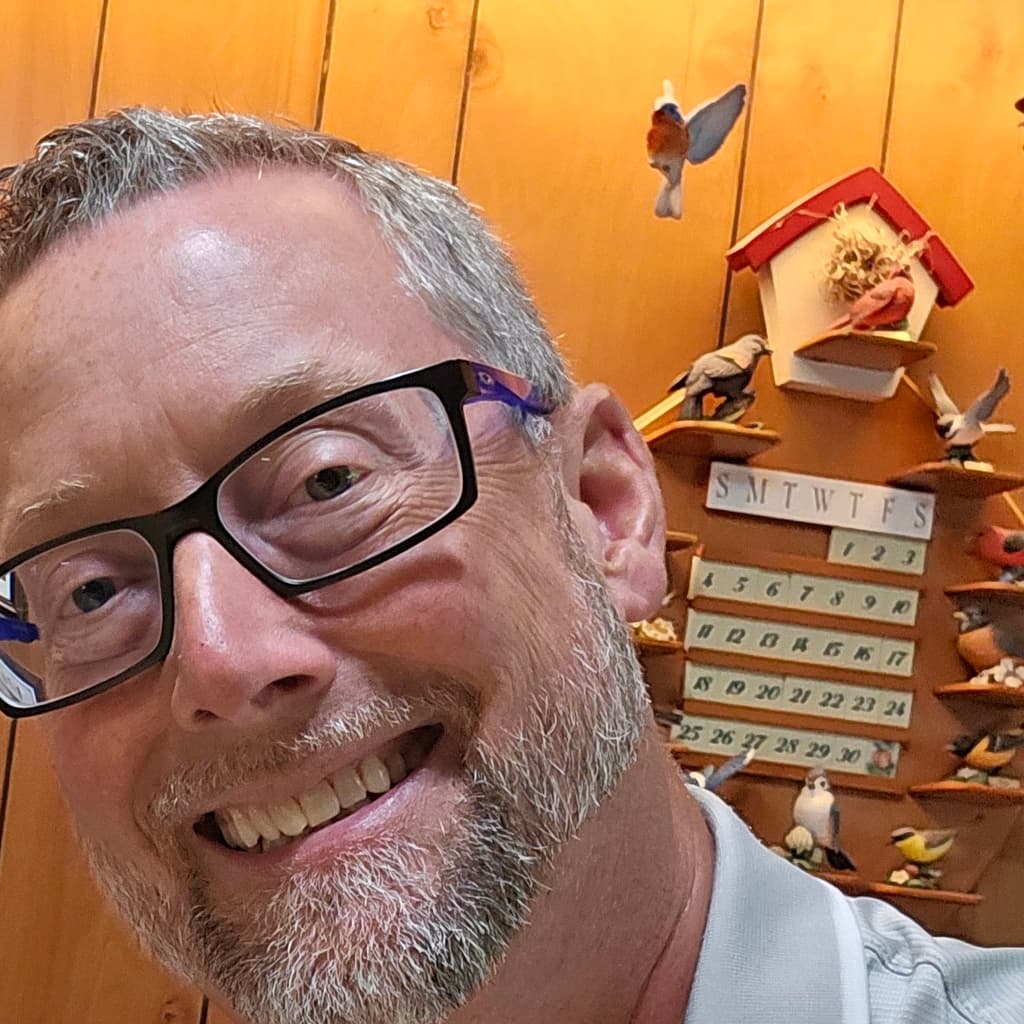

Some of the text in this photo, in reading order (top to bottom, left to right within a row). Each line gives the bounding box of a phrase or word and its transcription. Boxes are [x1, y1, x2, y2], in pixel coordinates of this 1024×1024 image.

[716, 473, 927, 528] S M T W T F S
[843, 542, 916, 565] 1 2 3
[702, 572, 911, 615] 4 5 6 7 8 9 10
[697, 624, 908, 667] 11 12 13 14 15 16 17
[693, 676, 905, 717] 18 19 20 21 22 23 24
[677, 725, 861, 763] 25 26 27 28 29 30
